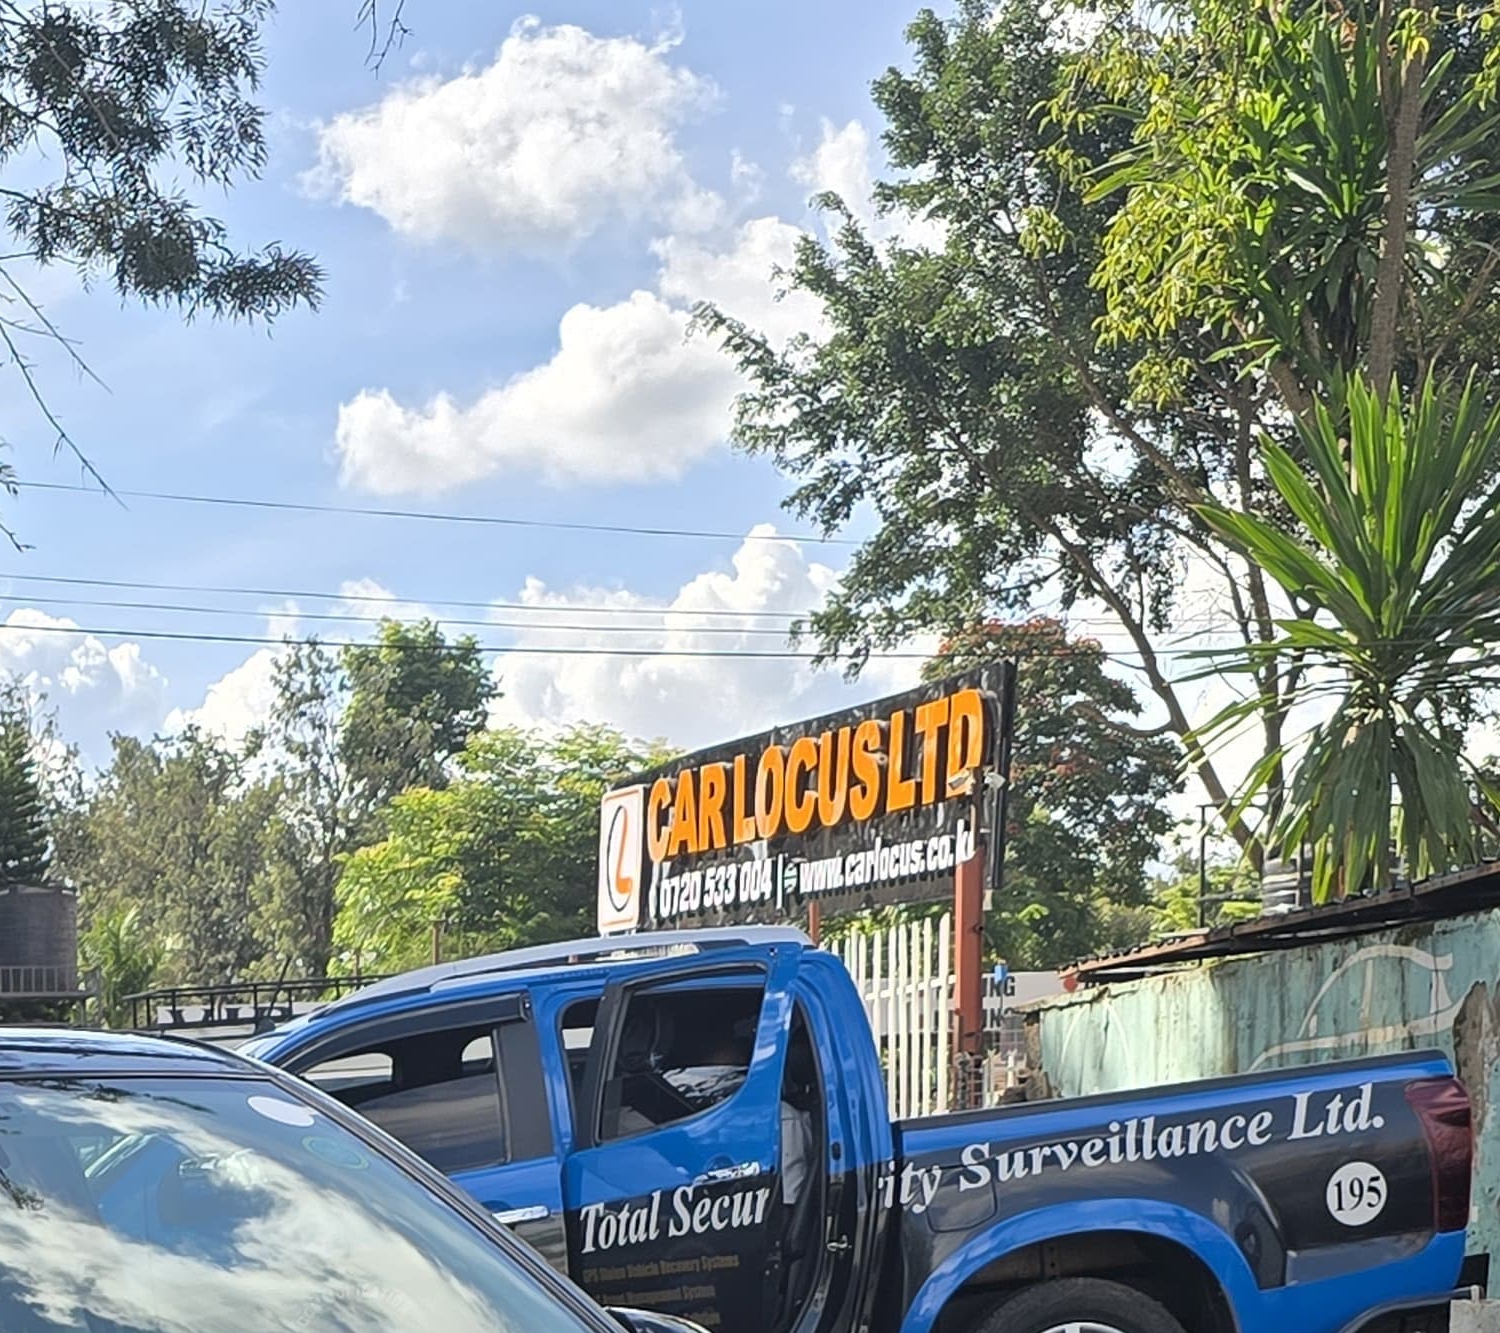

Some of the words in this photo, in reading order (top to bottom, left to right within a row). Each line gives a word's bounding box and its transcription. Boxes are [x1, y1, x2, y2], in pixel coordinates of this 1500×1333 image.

[647, 761, 726, 864] CAR
[733, 719, 882, 844] LOCUS
[886, 688, 984, 813] LTD
[659, 870, 702, 918] 0720
[703, 864, 736, 909] 533
[739, 857, 773, 901] 004
[580, 1190, 662, 1254] Total
[668, 1184, 771, 1239] Secur
[959, 1110, 1273, 1193] Surveillance
[1287, 1082, 1385, 1141] Ltd.
[1332, 1175, 1383, 1212] 195
